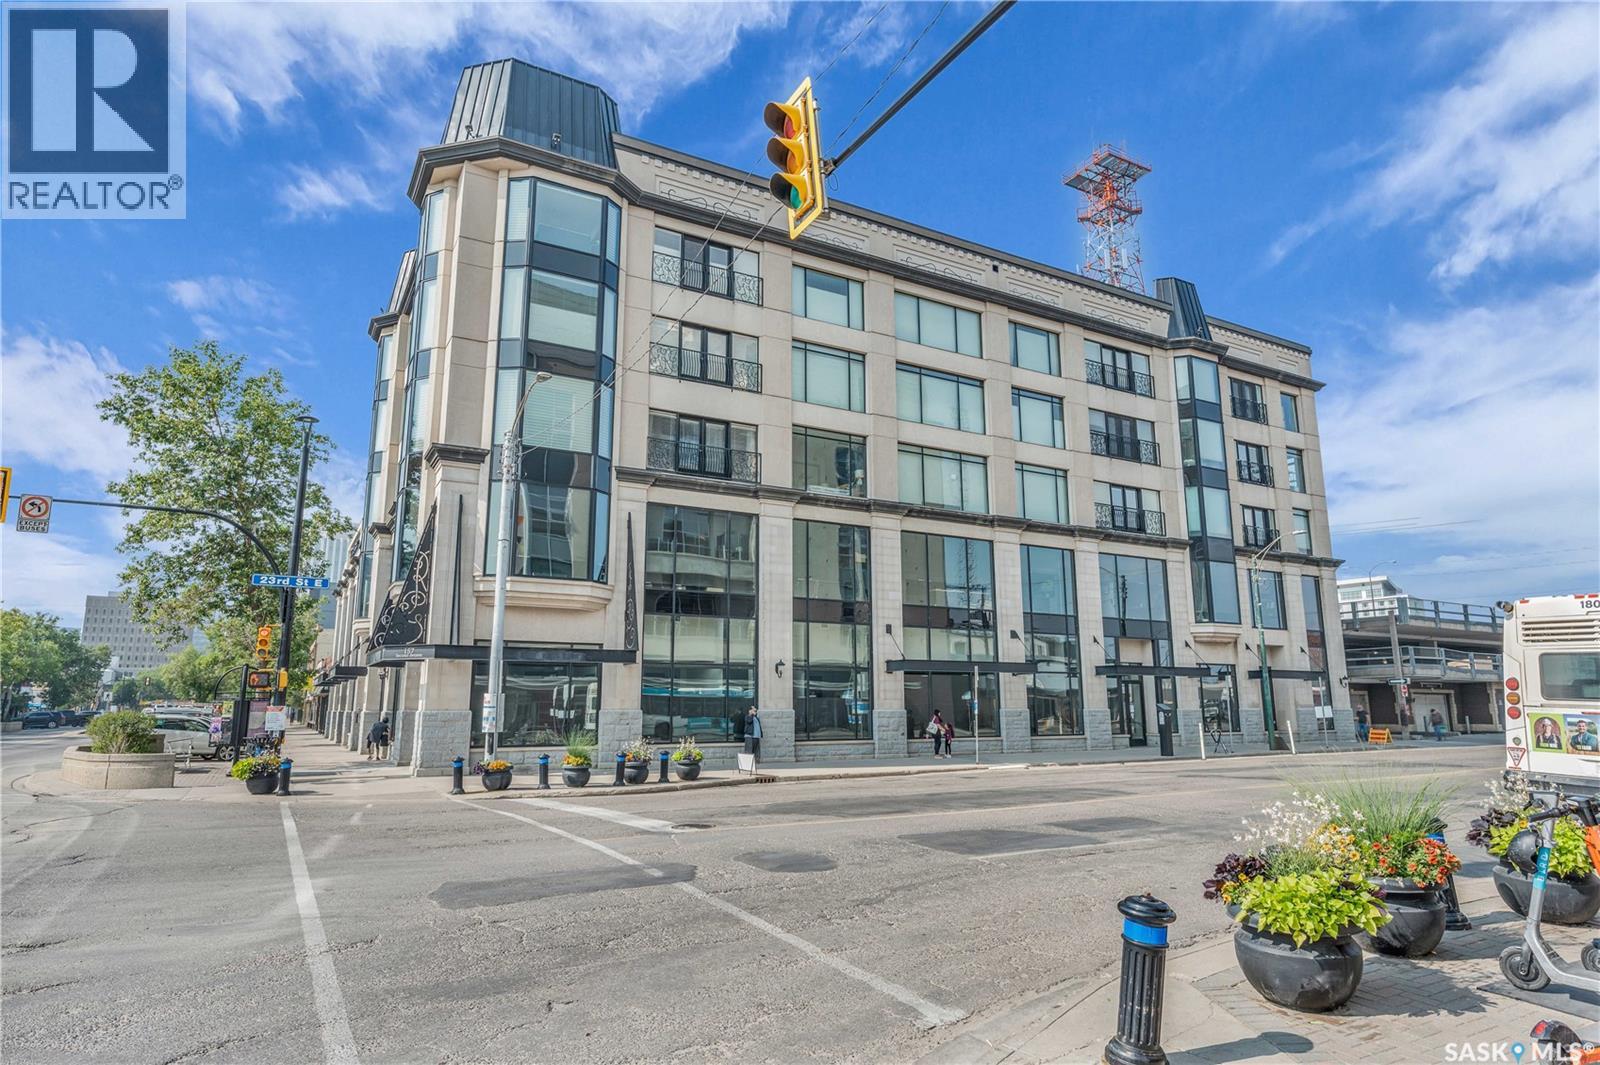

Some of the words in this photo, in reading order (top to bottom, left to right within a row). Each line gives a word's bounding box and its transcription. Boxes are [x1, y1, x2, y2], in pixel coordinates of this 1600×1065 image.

[260, 576, 290, 585] 23rd
[295, 578, 309, 586] St
[314, 579, 323, 587] E
